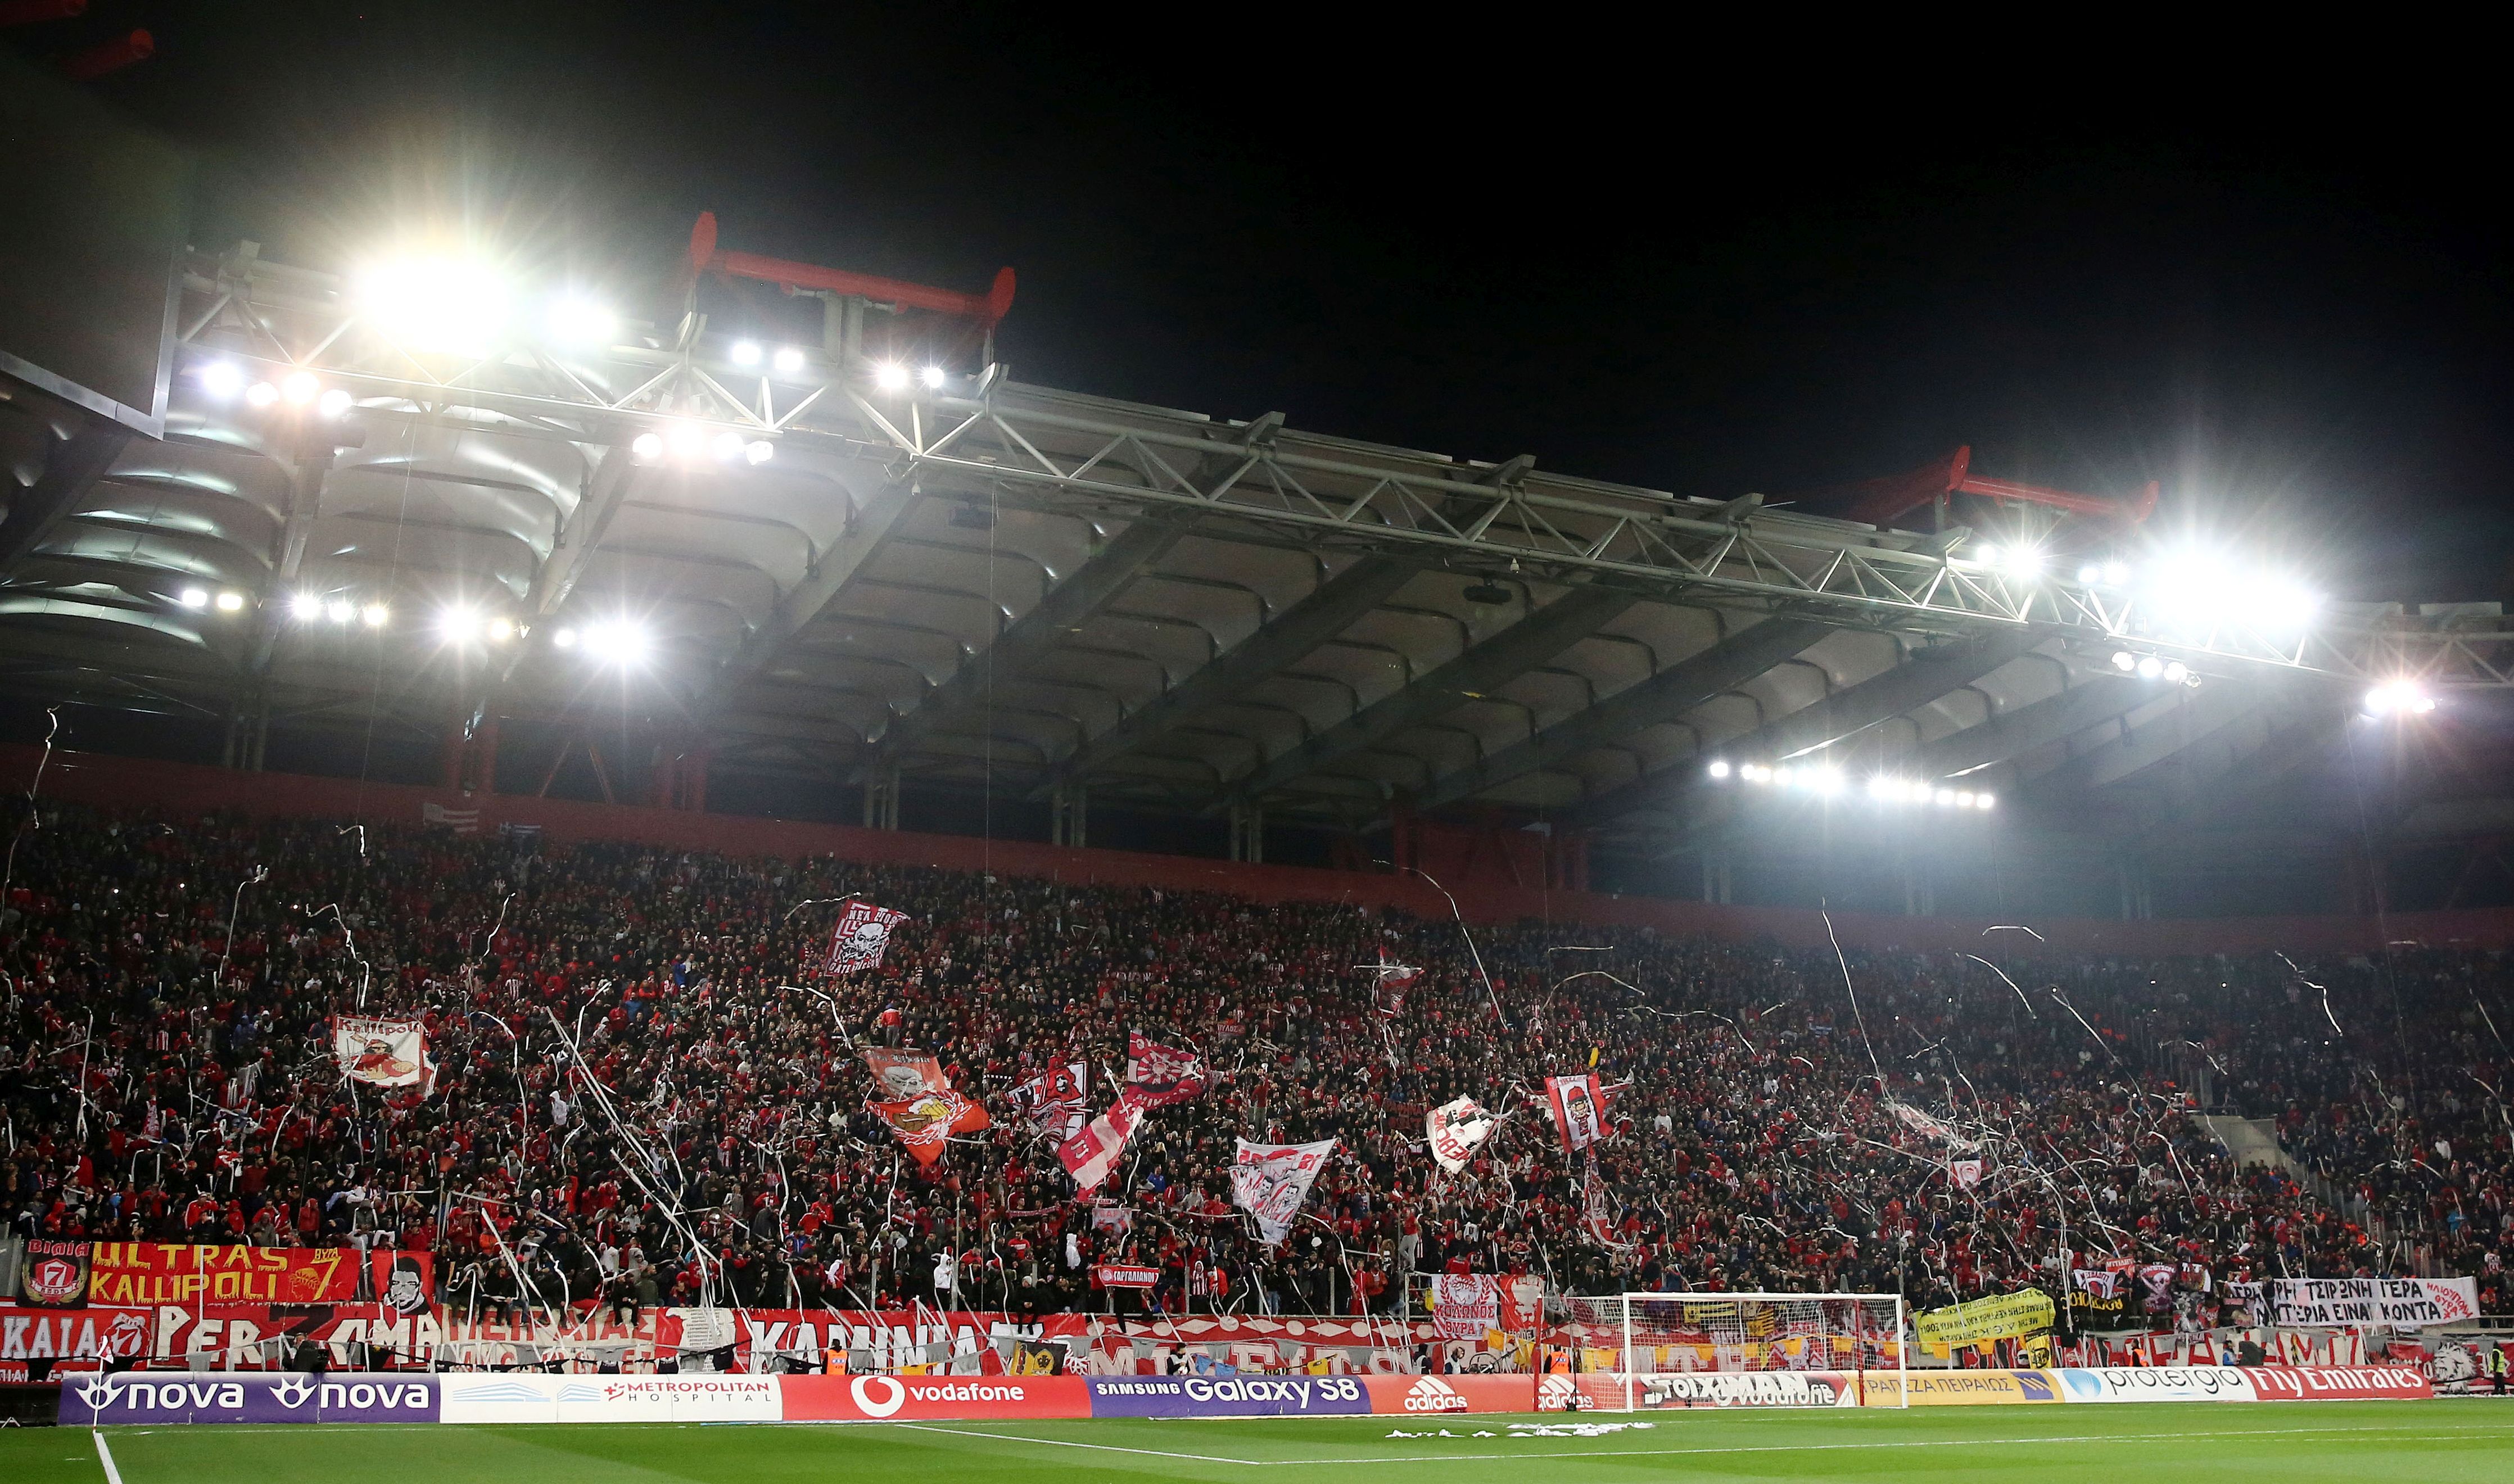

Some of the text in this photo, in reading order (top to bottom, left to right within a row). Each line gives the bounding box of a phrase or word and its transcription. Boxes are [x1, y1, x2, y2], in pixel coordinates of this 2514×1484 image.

[92, 1241, 288, 1271] ULTRAS
[89, 1270, 276, 1305] KALLIPOLI
[310, 1256, 342, 1301] 7
[2305, 1280, 2372, 1301] ΤΣΙΡΩΝΗ
[2381, 1281, 2423, 1298] ΓΕΡΑ
[1435, 1304, 1495, 1319] ΚΟΛΩΝΟΣ
[2333, 1302, 2373, 1321] ΕΙΝΑΙ
[2380, 1301, 2441, 1321] ΚΟΝΤΑ
[1445, 1320, 1486, 1336] ΘΥΡΑ 7
[628, 1382, 769, 1393] METROPOLITAN
[1937, 1377, 2014, 1392] ΠΕΙΡΑΙΩΣ
[2101, 1367, 2243, 1394] protergia
[2249, 1367, 2423, 1398] Fly Emirates
[128, 1383, 245, 1409] nova
[320, 1383, 429, 1409] nova
[628, 1393, 771, 1402] HOSPITAL
[909, 1383, 1025, 1401] vodafone
[1097, 1378, 1360, 1409] SAMSUNG Galaxy S8
[1404, 1393, 1468, 1411] adidas
